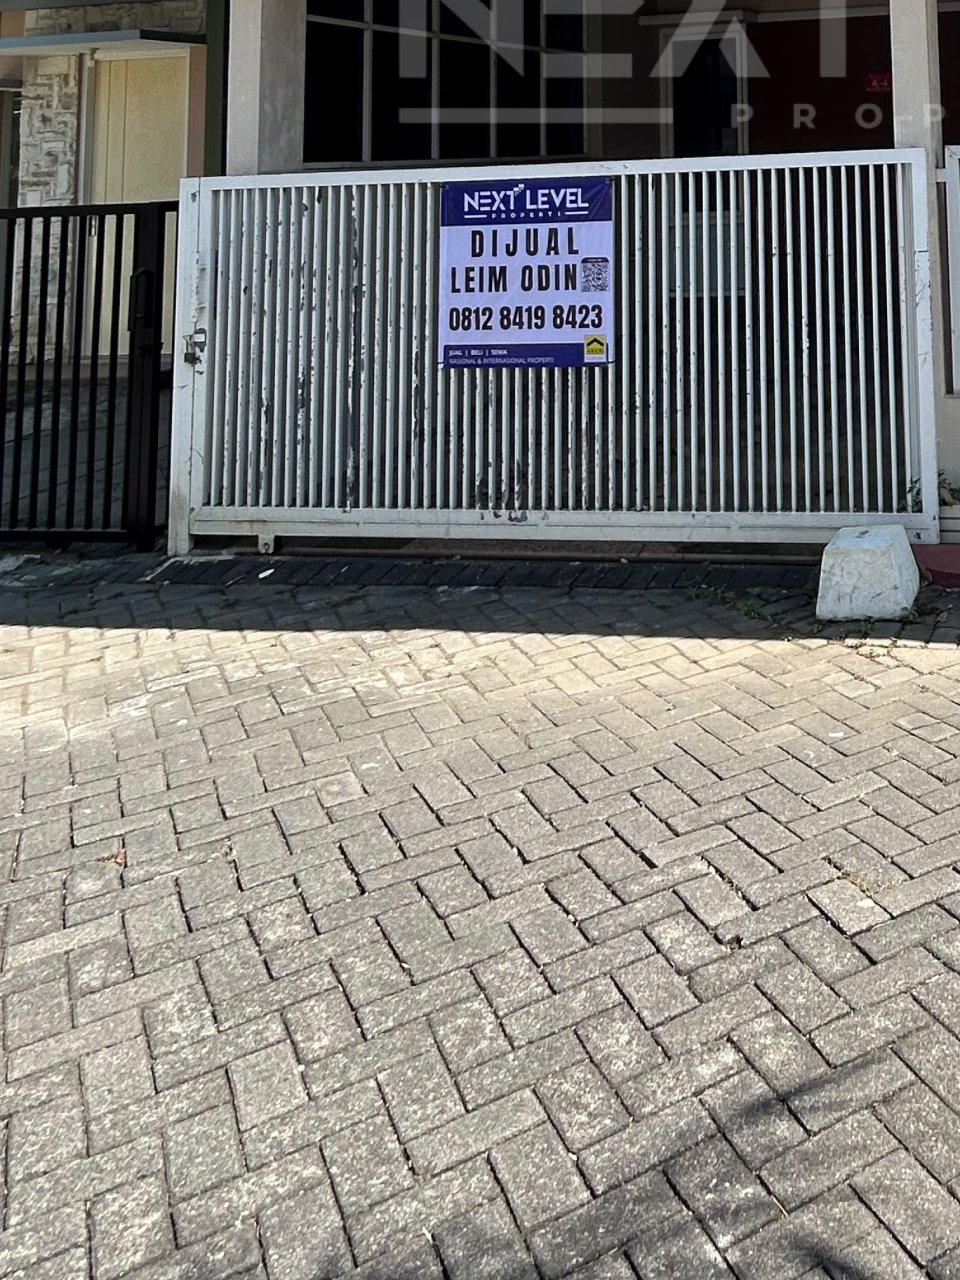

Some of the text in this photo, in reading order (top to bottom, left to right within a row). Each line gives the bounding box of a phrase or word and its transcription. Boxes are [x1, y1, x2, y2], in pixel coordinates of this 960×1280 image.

[464, 188, 589, 212] NEXT LEVEL
[491, 211, 561, 219] PROPERTI
[471, 227, 579, 258] DIJUAL
[451, 264, 577, 293] LEIM ODIN
[449, 304, 603, 331] 0812 8419 8423
